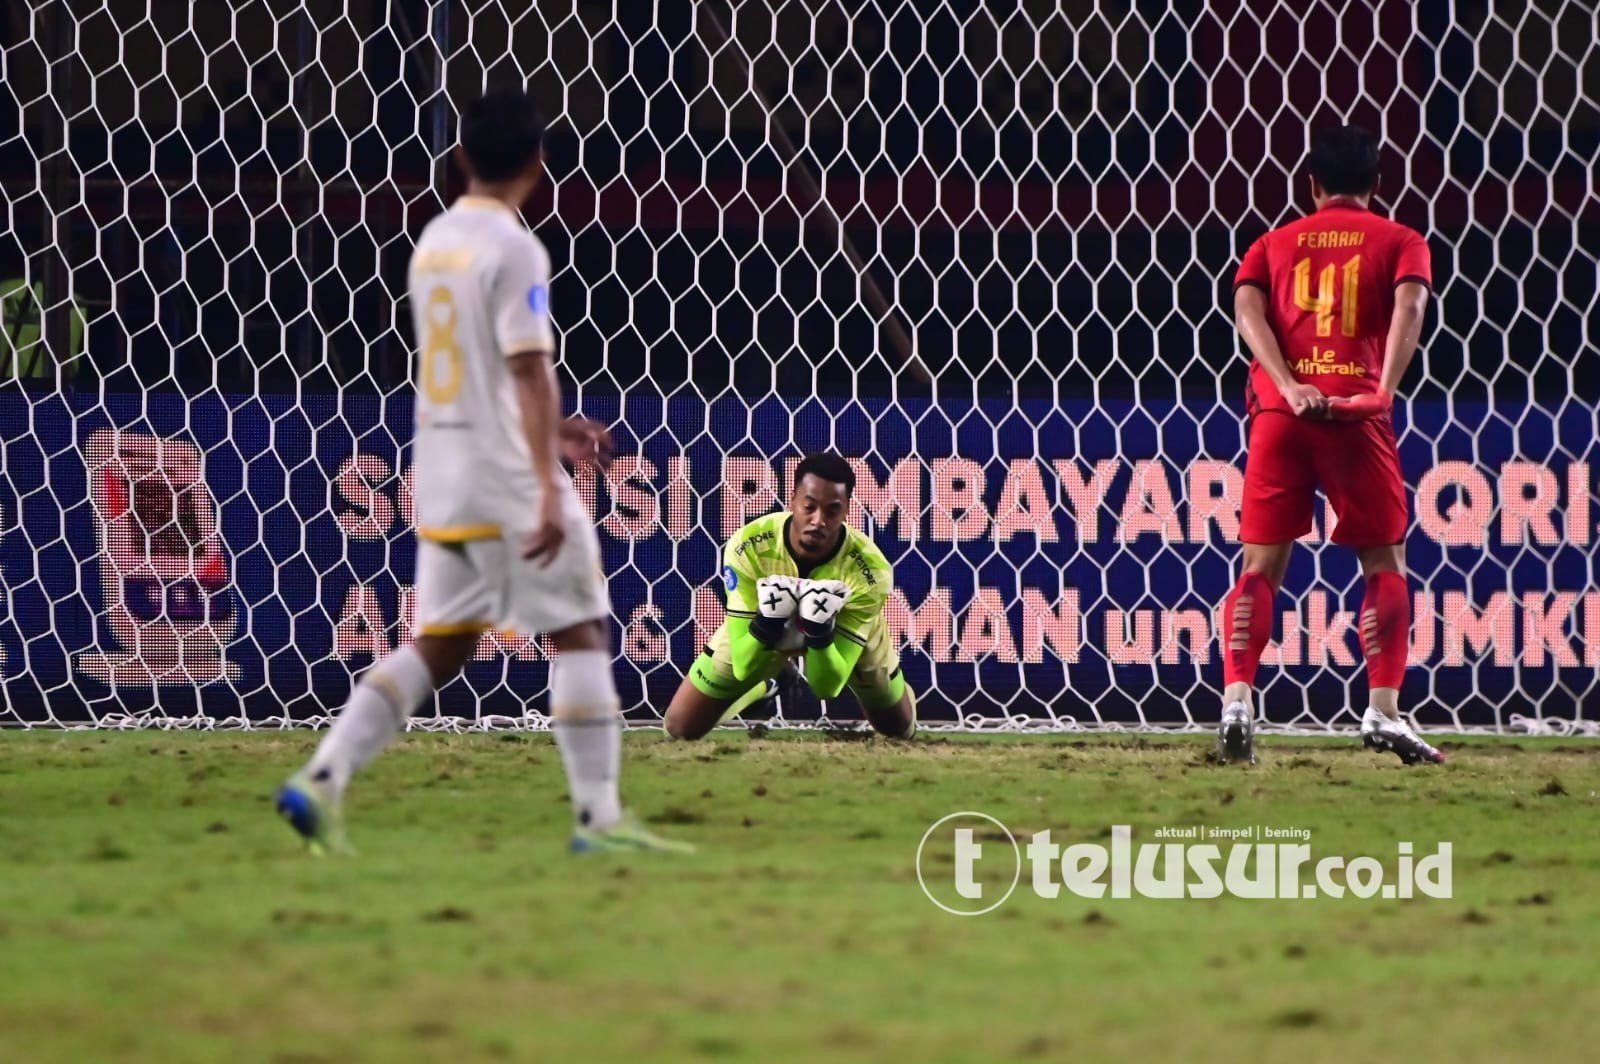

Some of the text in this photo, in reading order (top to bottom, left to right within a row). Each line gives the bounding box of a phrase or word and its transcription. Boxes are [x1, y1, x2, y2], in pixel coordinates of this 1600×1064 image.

[1293, 254, 1361, 337] 41
[422, 284, 464, 406] 8
[1286, 358, 1366, 377] Minerale
[1312, 346, 1336, 364] Le
[1415, 460, 1600, 548] QRI
